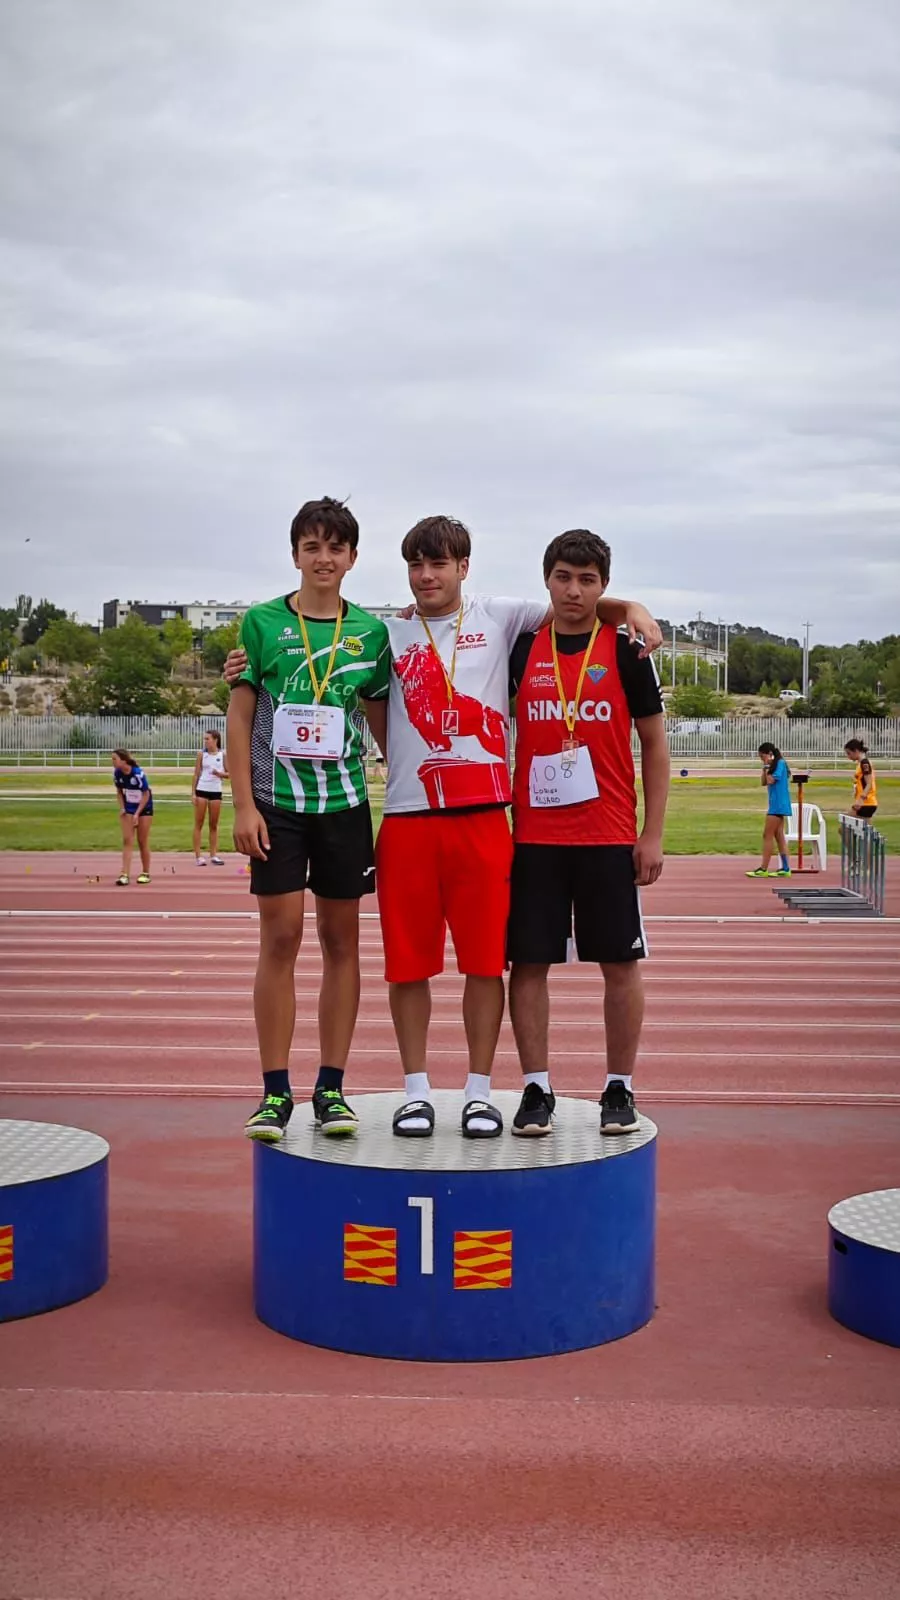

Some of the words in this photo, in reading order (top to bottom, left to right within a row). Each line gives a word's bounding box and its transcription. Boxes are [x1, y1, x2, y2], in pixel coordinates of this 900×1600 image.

[456, 633, 486, 645] ZGZ
[527, 699, 612, 722] HINACO
[407, 1196, 434, 1275] 1
